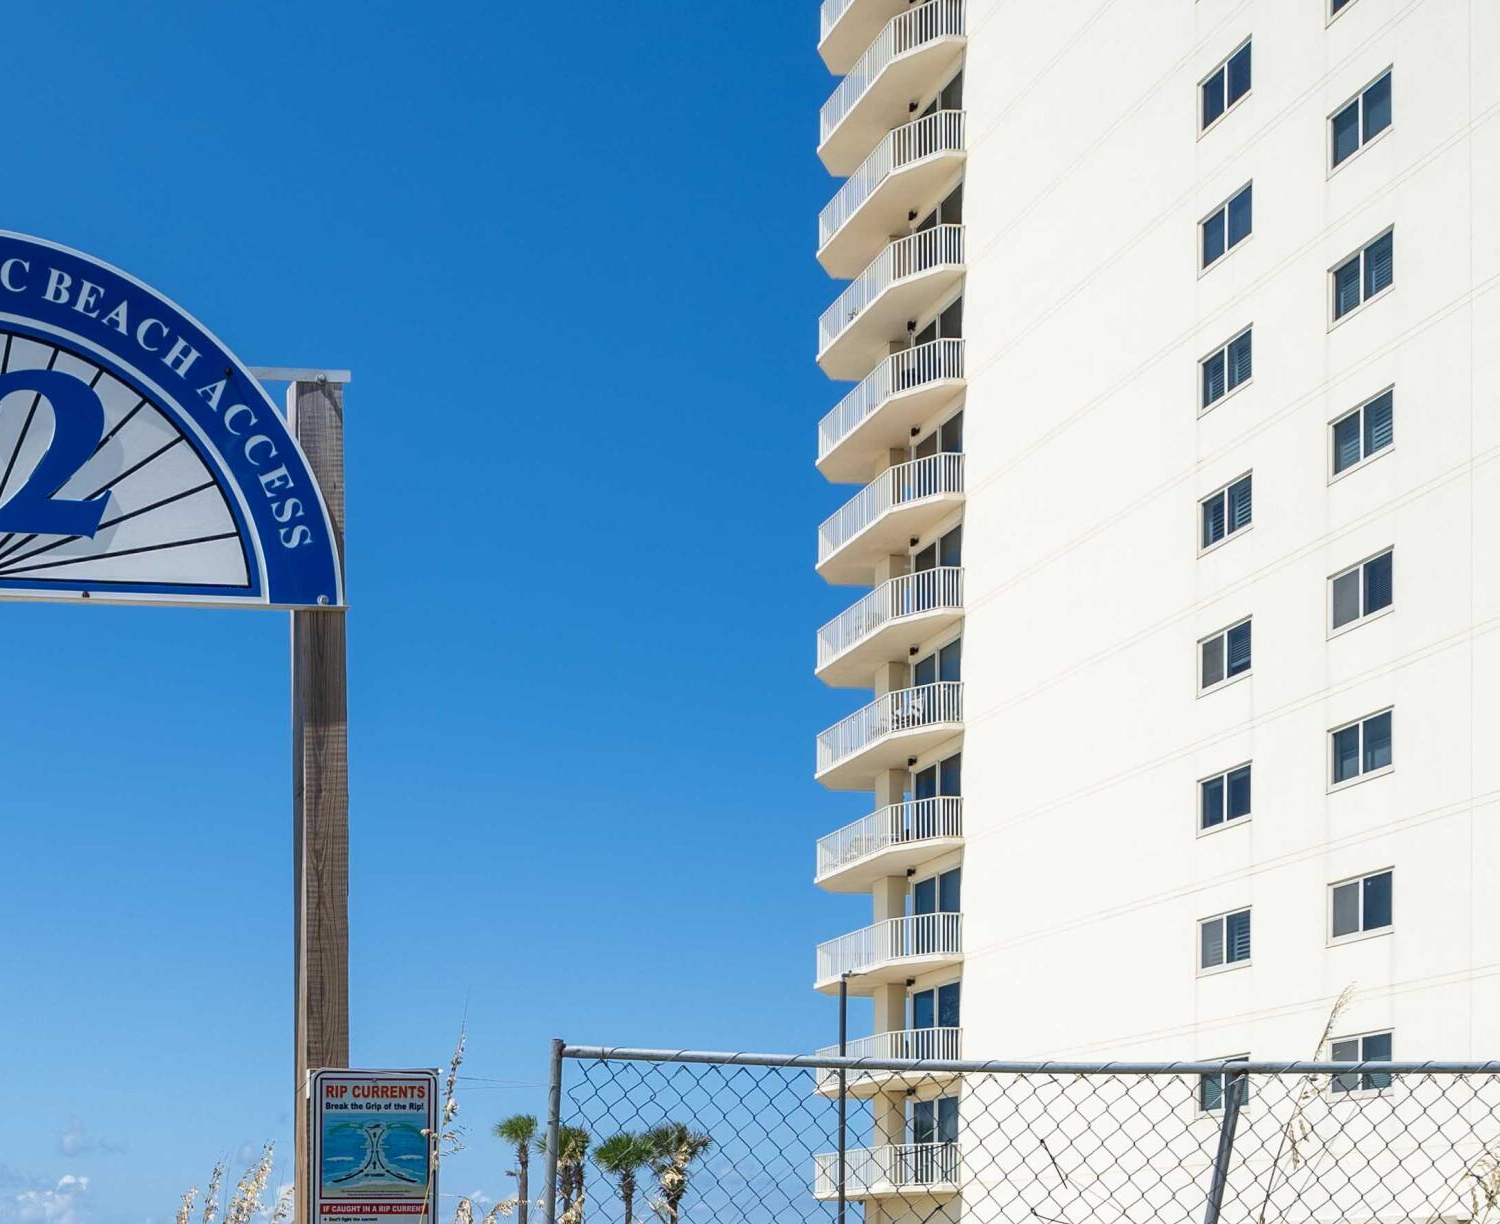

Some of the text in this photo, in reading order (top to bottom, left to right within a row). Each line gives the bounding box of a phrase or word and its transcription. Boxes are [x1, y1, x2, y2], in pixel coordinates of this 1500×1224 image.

[42, 267, 203, 380] BEACH
[197, 377, 312, 549] ACCESS
[325, 1085, 426, 1099] RIP CURRENTS
[325, 1101, 425, 1112] Break the Grip of the Rip!
[322, 1205, 331, 1213] IF
[331, 1205, 362, 1213] CAUGHT
[362, 1205, 371, 1213] IN
[378, 1205, 391, 1213] RIP
